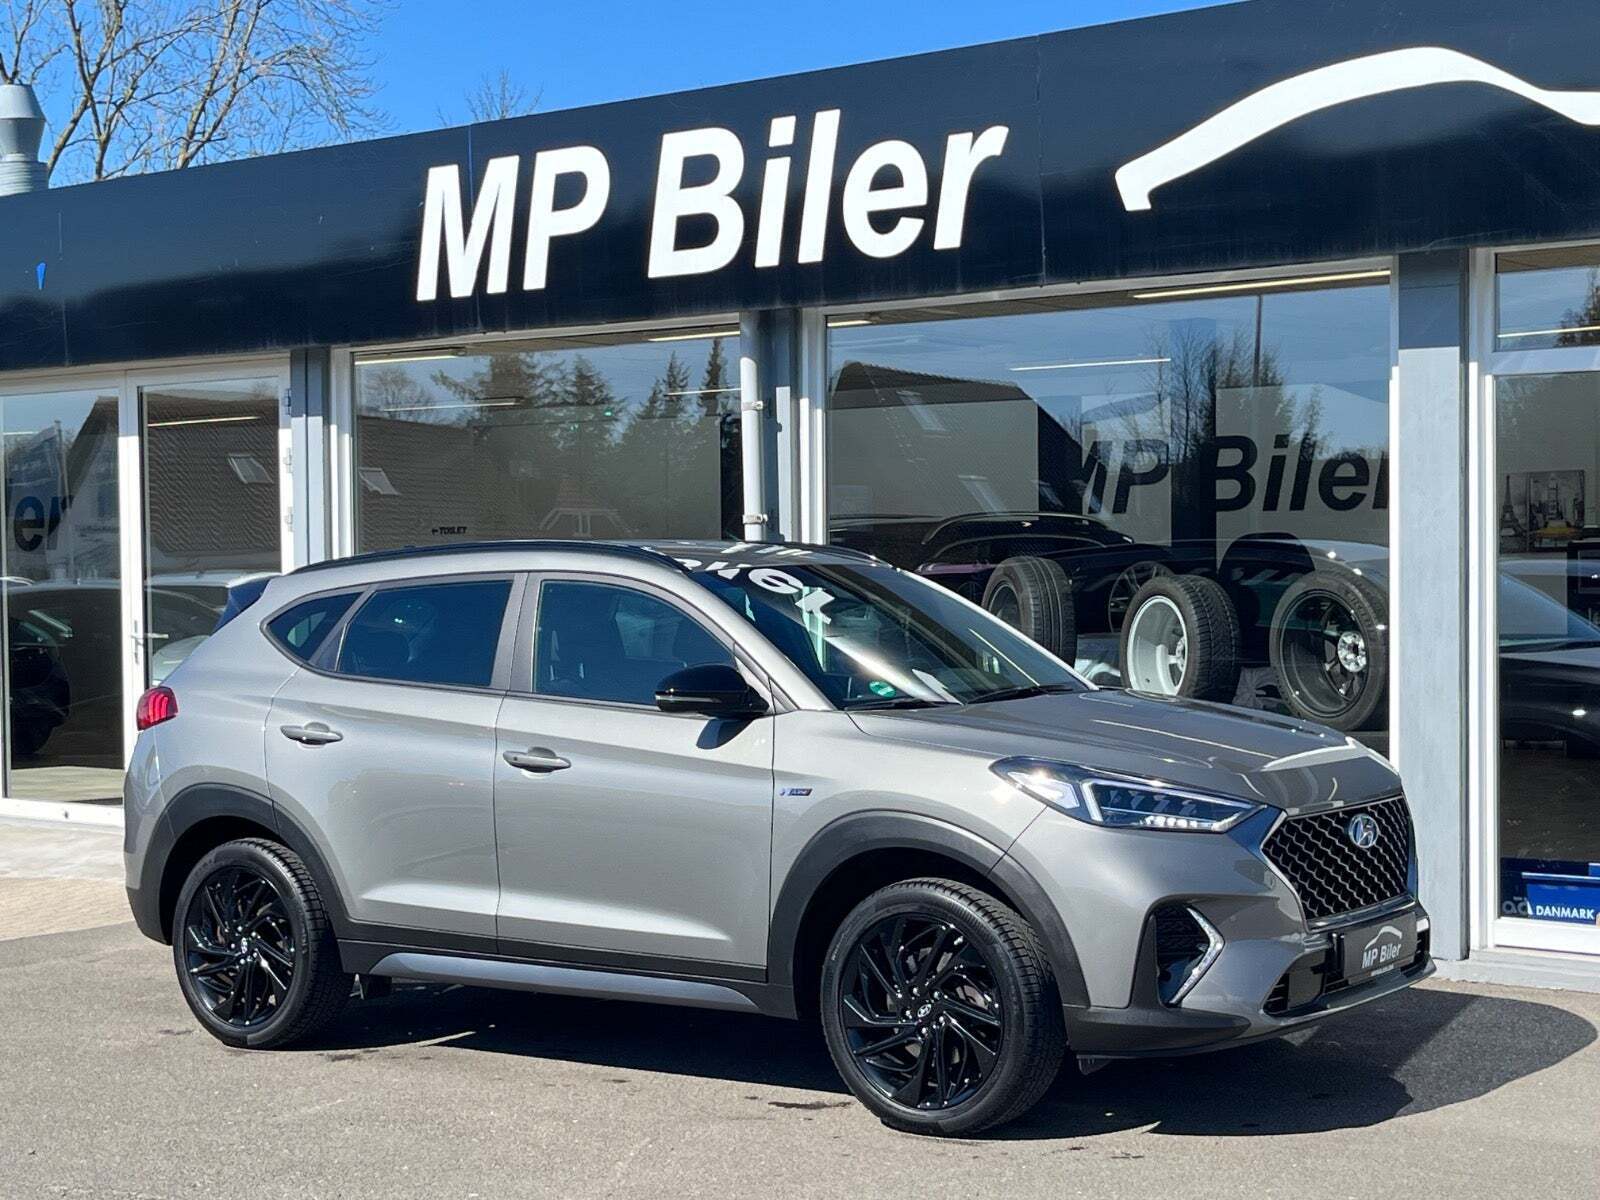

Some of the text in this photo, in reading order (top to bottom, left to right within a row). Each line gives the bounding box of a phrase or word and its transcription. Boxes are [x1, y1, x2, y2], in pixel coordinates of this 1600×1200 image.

[416, 108, 1010, 302] MP Biler
[1535, 904, 1596, 920] DANMARK
[1362, 943, 1402, 969] MP Biler
